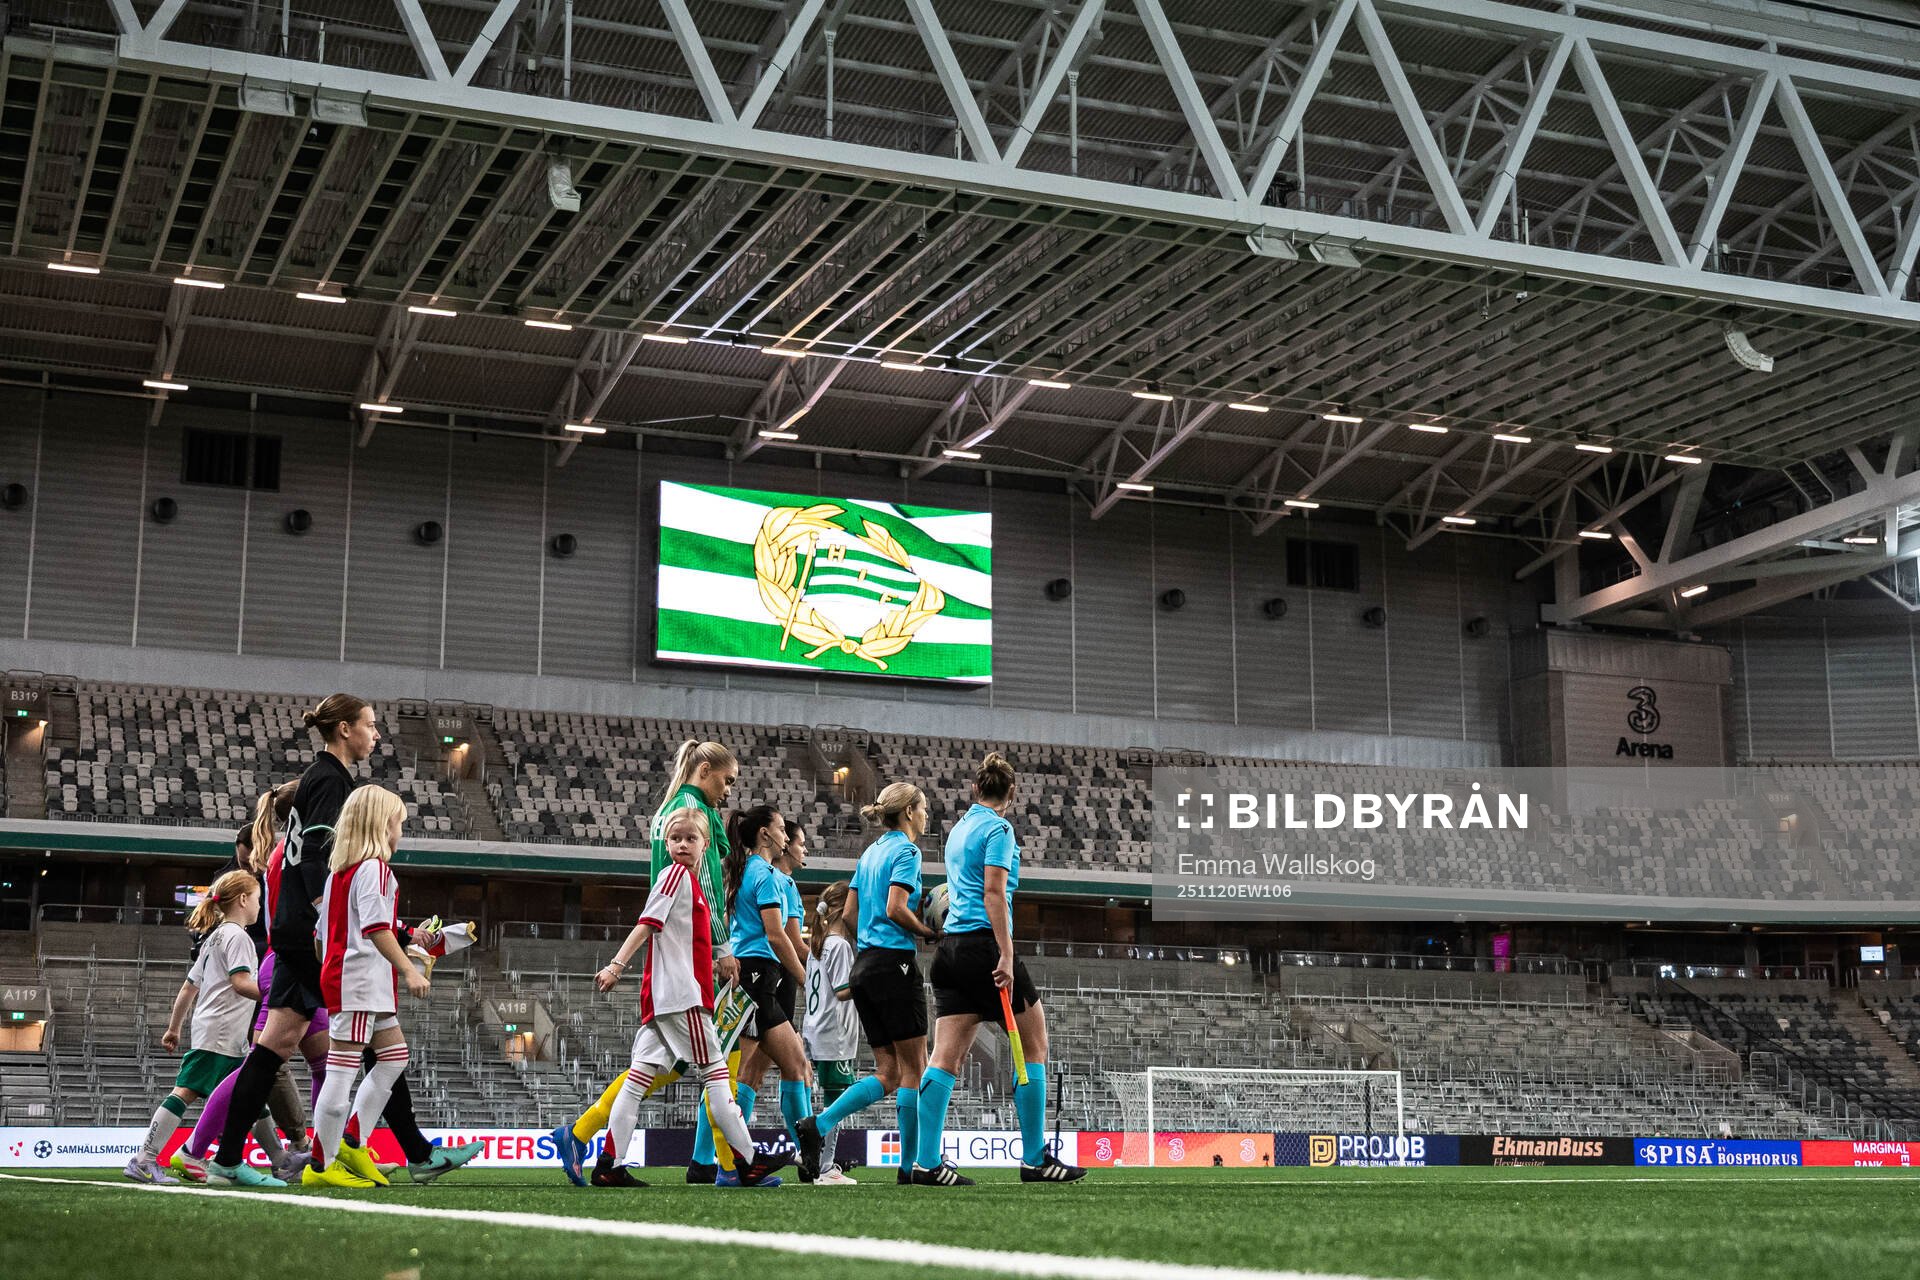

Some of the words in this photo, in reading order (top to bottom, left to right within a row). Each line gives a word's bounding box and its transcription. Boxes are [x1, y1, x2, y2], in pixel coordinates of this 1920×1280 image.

[11, 690, 38, 701] B319
[438, 719, 462, 729] B318
[1616, 737, 1673, 758] Arena
[4, 989, 37, 1000] A119
[498, 1002, 527, 1013] A118
[969, 1137, 1064, 1160] GROP
[1340, 1136, 1425, 1158] PROJOB
[1492, 1136, 1604, 1157] EkmanBuss
[1640, 1143, 1714, 1164] SPISA
[1718, 1154, 1798, 1164] BOSPHORUS
[1853, 1143, 1909, 1154] MARGINAL
